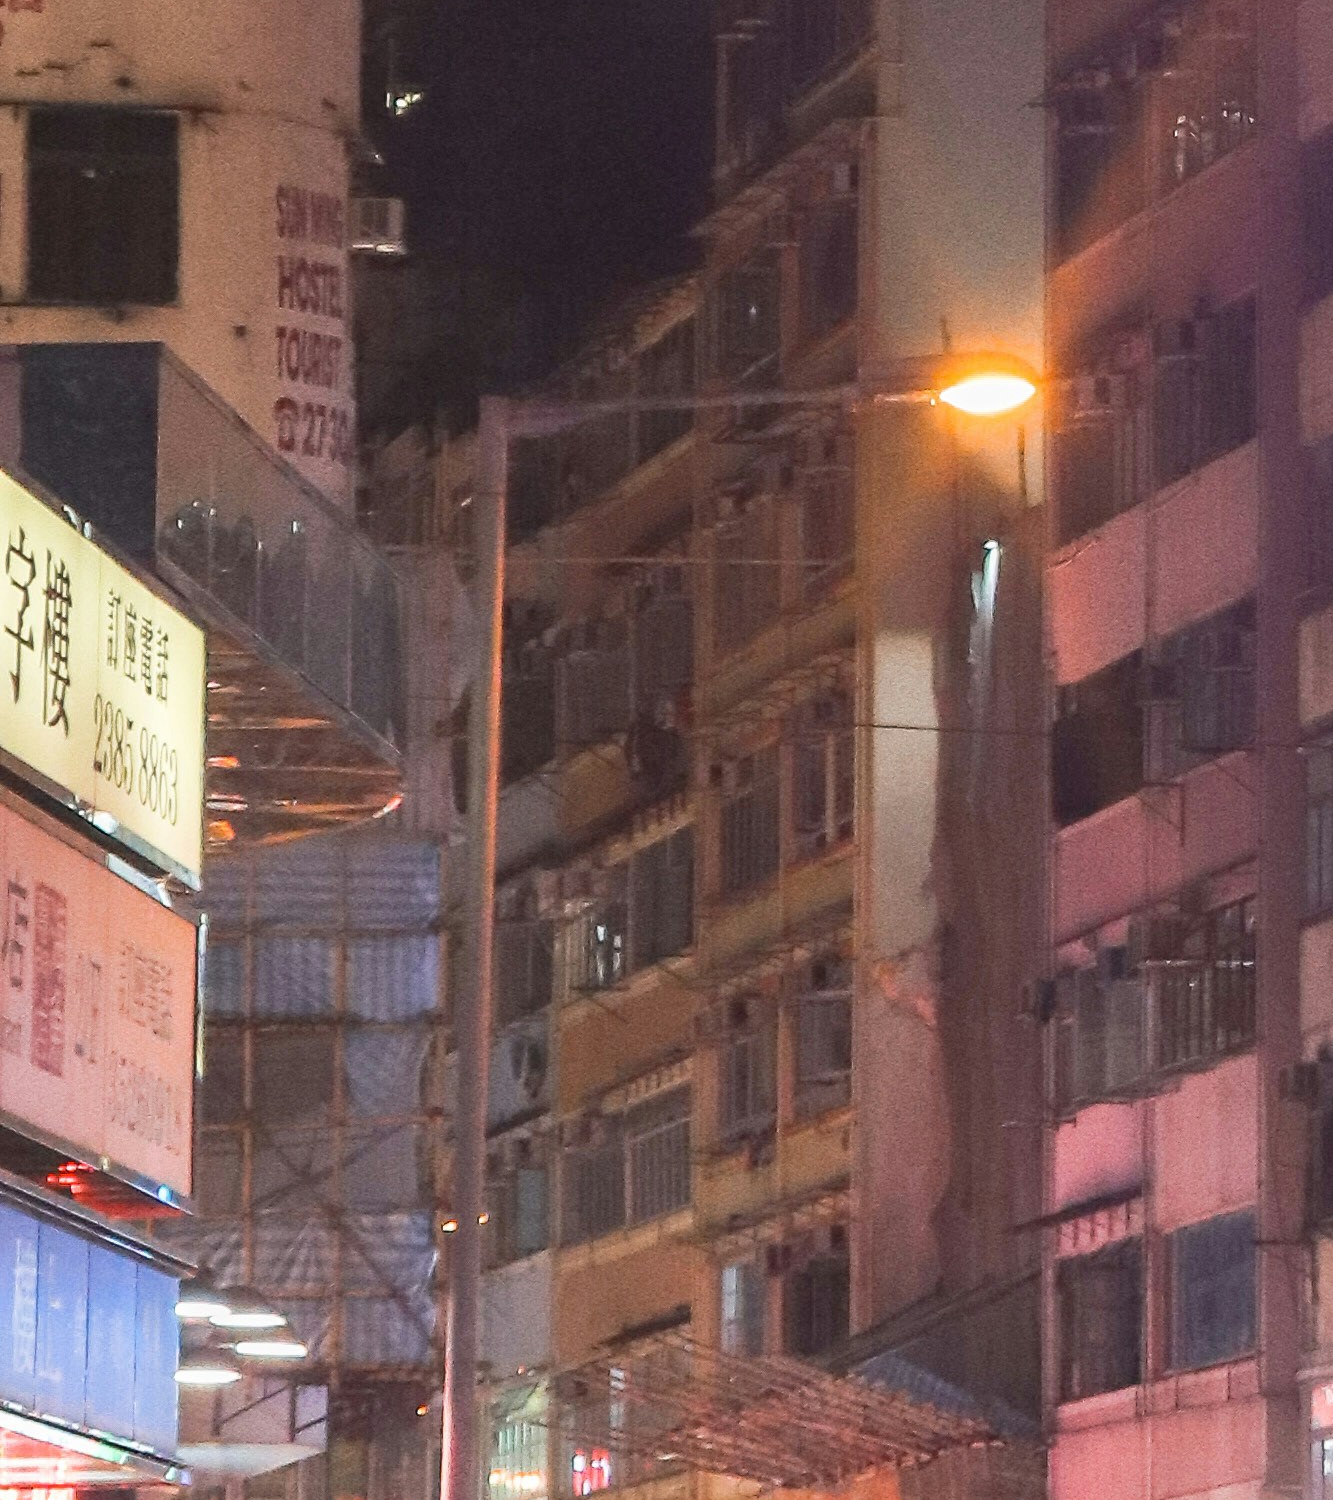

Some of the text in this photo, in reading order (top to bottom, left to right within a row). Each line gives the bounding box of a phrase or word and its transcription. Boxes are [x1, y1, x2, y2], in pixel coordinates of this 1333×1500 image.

[277, 254, 343, 319] HOSTEL
[93, 691, 179, 829] 2385 8863
